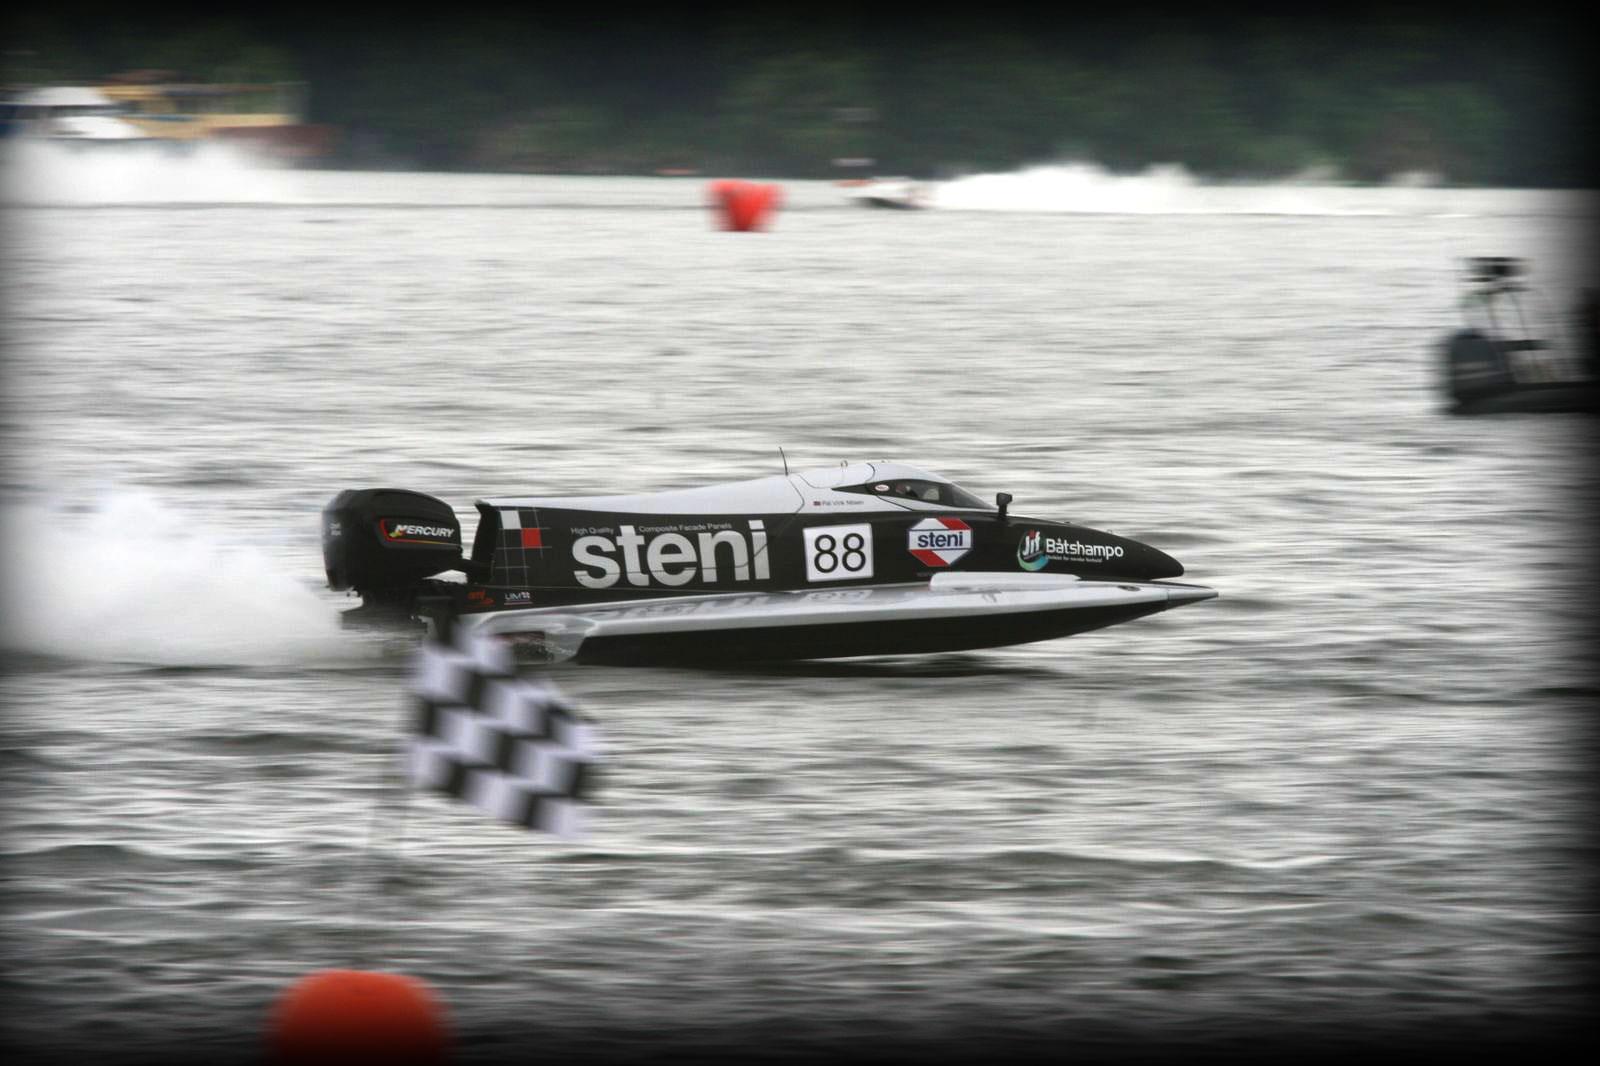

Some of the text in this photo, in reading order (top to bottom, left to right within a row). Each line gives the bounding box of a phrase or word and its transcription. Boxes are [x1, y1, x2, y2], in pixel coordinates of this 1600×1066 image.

[394, 524, 455, 538] MERCURY
[570, 522, 733, 536] High Quality Composite Facade Panels
[917, 531, 964, 548] steni
[1045, 537, 1124, 560] Båtshampo
[572, 520, 769, 589] steni
[814, 533, 867, 573] 88
